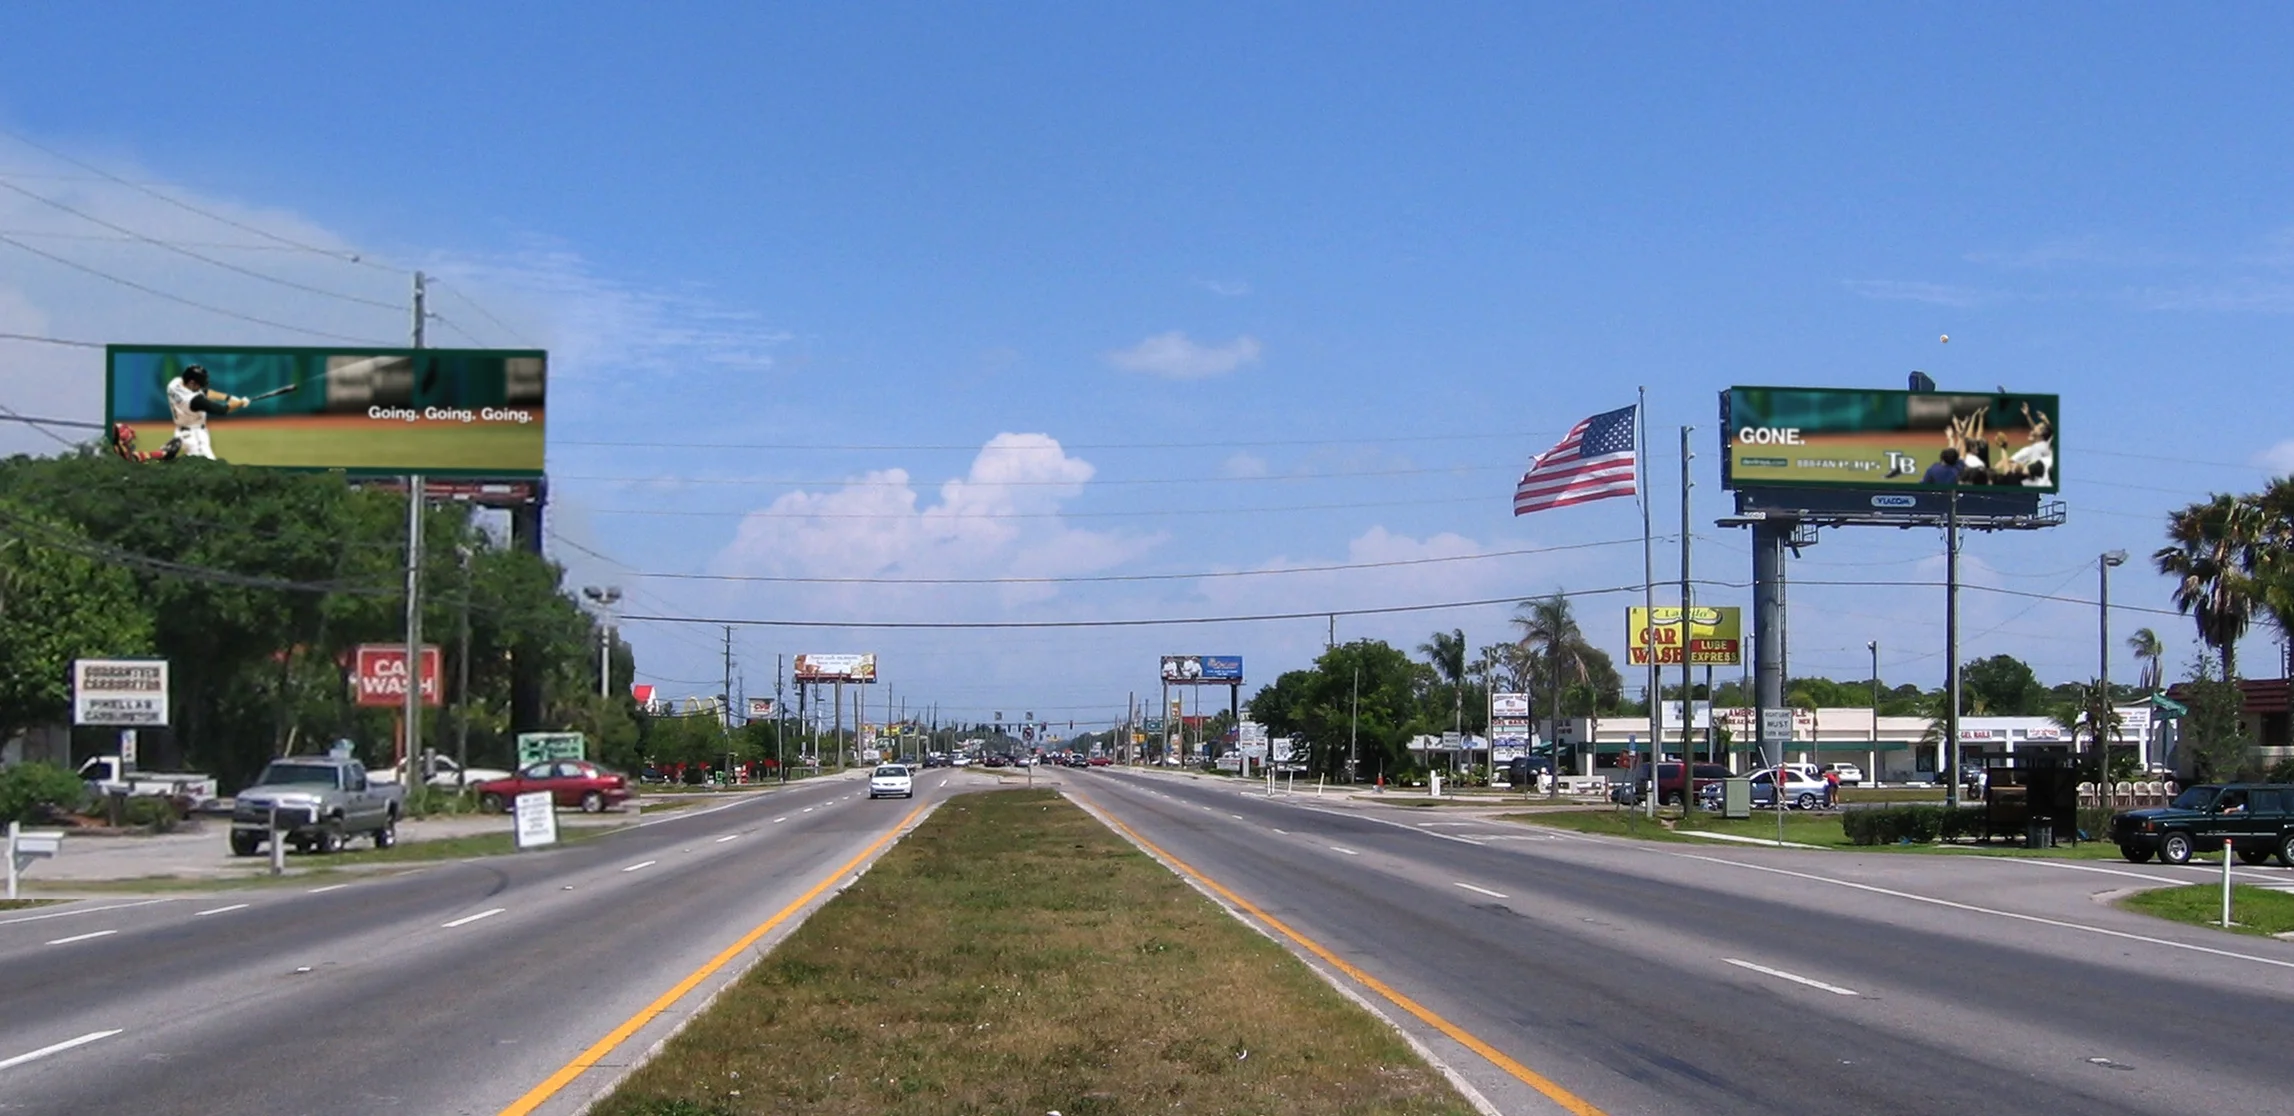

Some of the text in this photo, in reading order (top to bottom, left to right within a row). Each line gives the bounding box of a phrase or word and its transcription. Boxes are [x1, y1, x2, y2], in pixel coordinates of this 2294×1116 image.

[368, 405, 533, 424] Going. Going. Going.
[1739, 426, 1806, 445] GONE.
[1876, 496, 1911, 505] VIACOM
[1640, 628, 1677, 645] CAR
[1701, 640, 1727, 650] LUBE
[1691, 652, 1737, 661] EXPRESS
[1767, 720, 1788, 728] MUST
